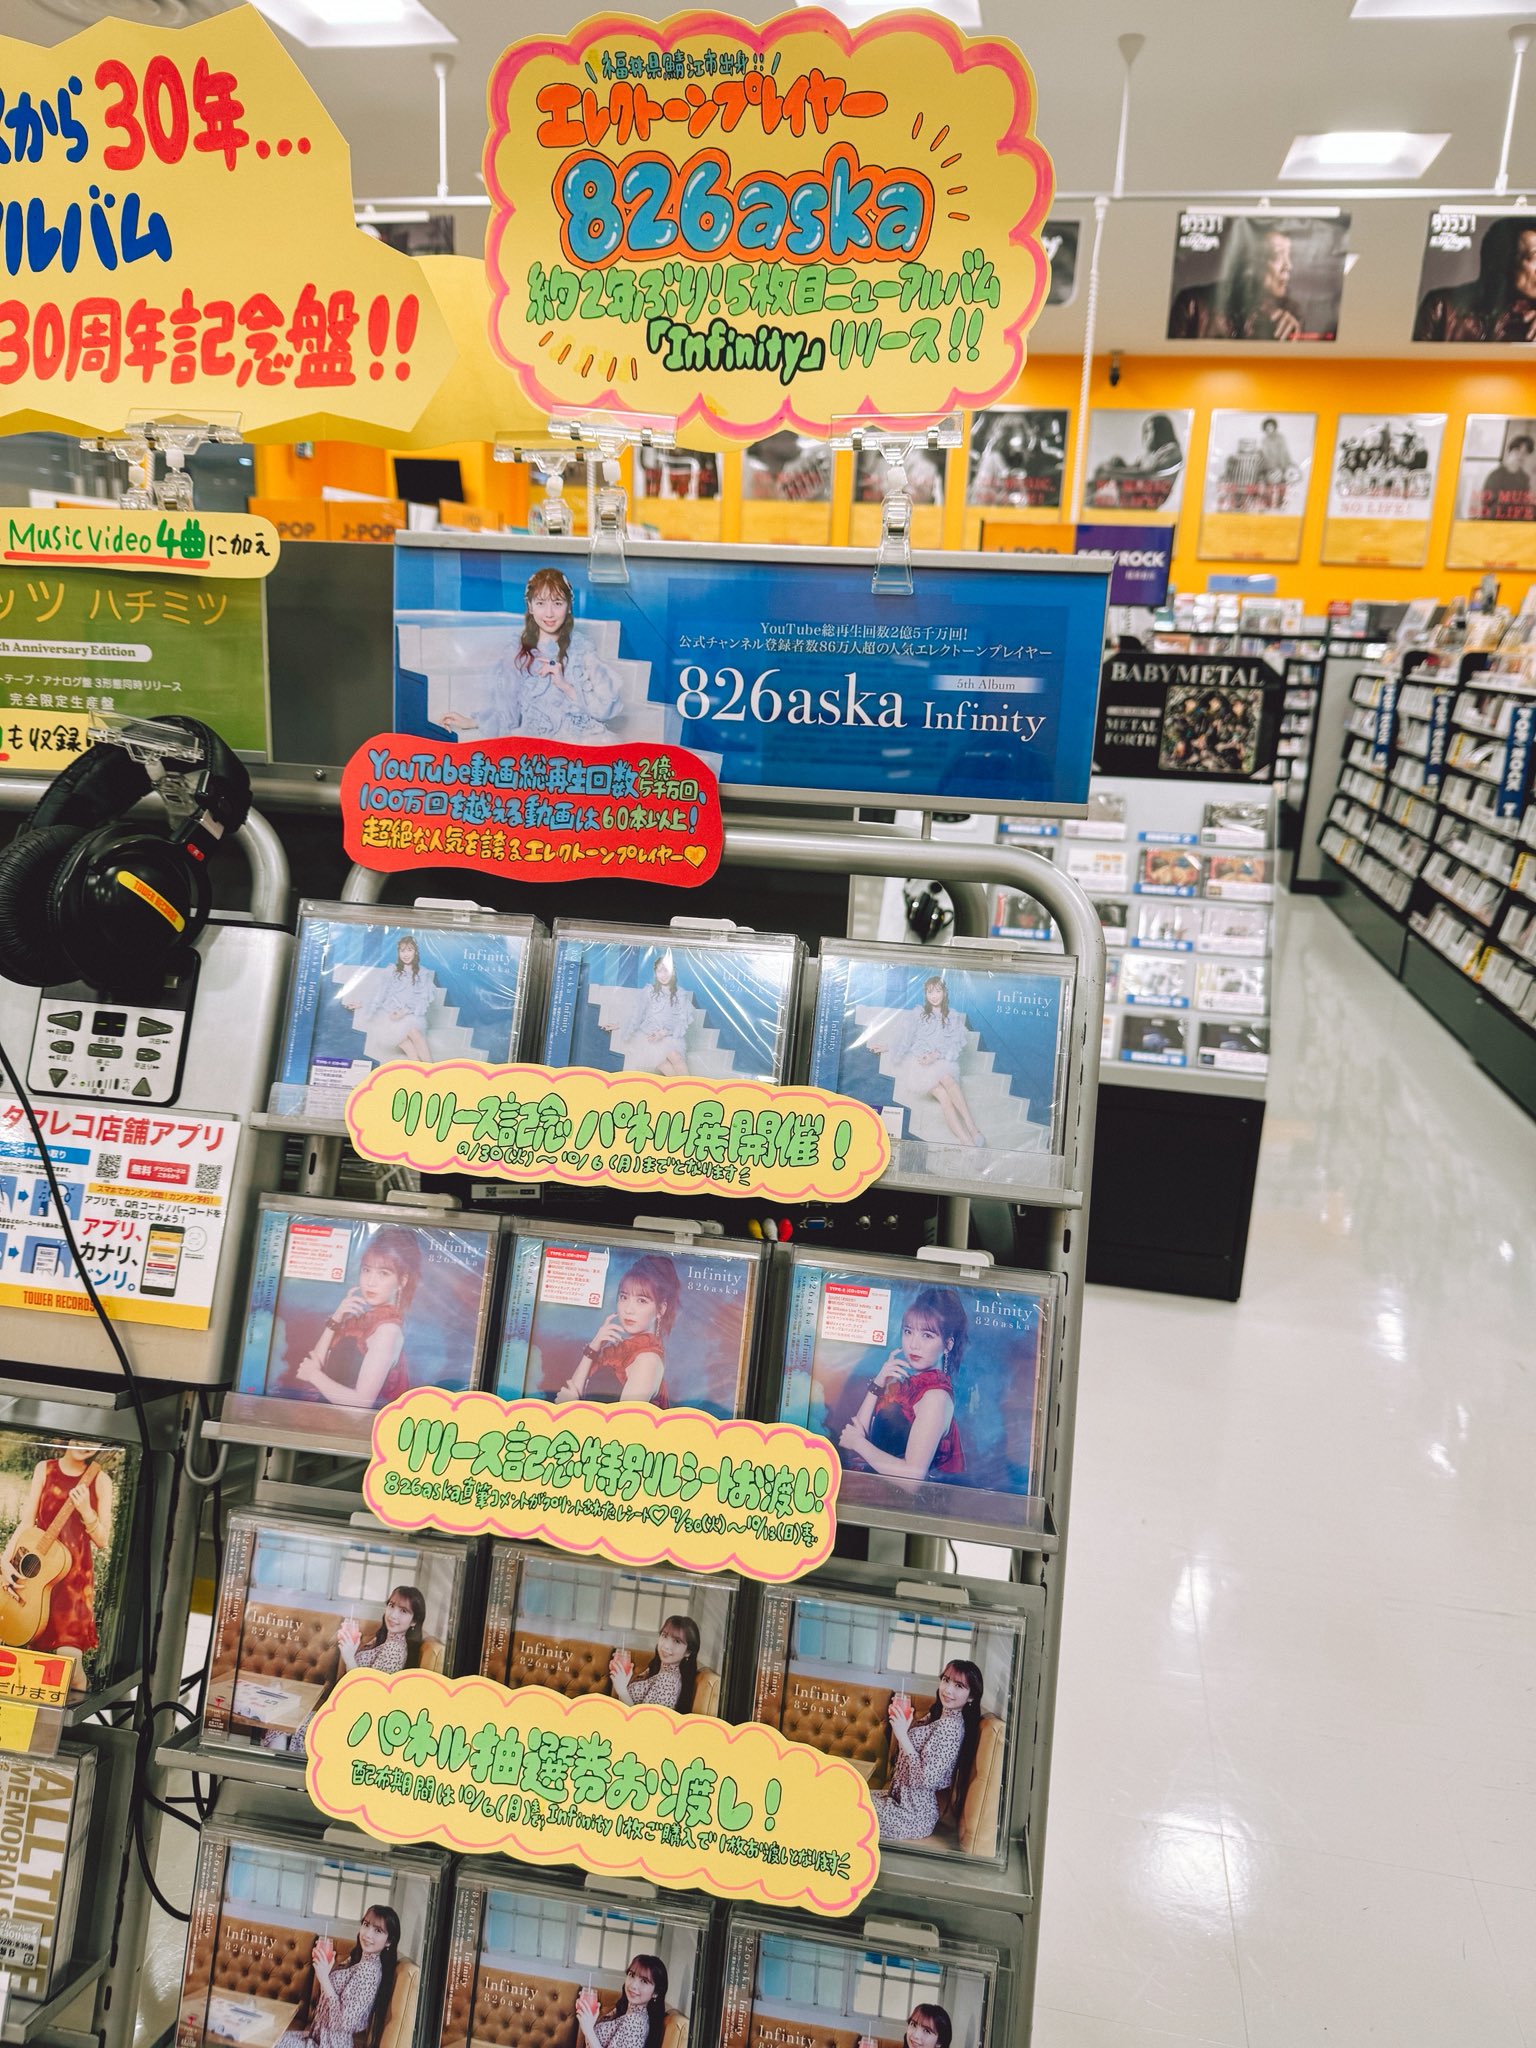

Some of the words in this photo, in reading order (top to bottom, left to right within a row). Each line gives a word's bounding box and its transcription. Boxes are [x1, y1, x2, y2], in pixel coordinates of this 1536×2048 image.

[0, 56, 311, 171] から30年...
[536, 69, 887, 148] エレクトーンプレイヤー
[553, 142, 935, 269] 826aska
[0, 185, 171, 275] ルバム
[526, 248, 1000, 324] 約2年ぶり!5枚目ニューアルバム
[90, 589, 227, 625] ハチミツ
[13, 643, 89, 657] Anniversary
[90, 645, 136, 658] Edition
[679, 635, 1052, 660] 公式チャンネル登録者数86万人超の人気エレクトーンプレイヤー
[956, 678, 975, 690] 5th
[978, 679, 1016, 691] Album
[1111, 662, 1265, 687] BABYMETAL
[10, 693, 115, 711] 完全限定生産盤
[676, 665, 908, 730] 826aska
[922, 701, 1046, 742] Infinity
[1105, 718, 1159, 732] METAL
[1104, 732, 1158, 747] FORTH
[996, 990, 1052, 1008] Infinity
[2, 1105, 224, 1152] タワレコ店舗アプリ
[131, 1164, 152, 1176] 無料
[82, 1218, 142, 1242] アプリ、
[80, 1242, 139, 1266] カナリ、
[429, 1239, 482, 1255] Infinity
[687, 1266, 742, 1284] Infinity
[687, 1282, 739, 1295] 826aska
[23, 1290, 54, 1307] TOWER
[55, 1294, 95, 1312] RECORDS
[974, 1301, 1033, 1320] Infinity
[974, 1315, 1031, 1331] 826aska
[799, 1335, 811, 1369] Infinity
[252, 1612, 303, 1631] Infinity
[777, 1602, 789, 1653] 826aska
[250, 1626, 302, 1642] 826aska
[496, 1617, 508, 1653] Infinity
[520, 1641, 574, 1661] Infinity
[519, 1656, 571, 1674] 826aska
[770, 1660, 782, 1698] Infinity
[794, 1684, 850, 1708] Infinity
[793, 1700, 848, 1717] 826aska
[347, 1709, 783, 1831] パネル抽選券お渡し!
[205, 1901, 216, 1938] Infinity
[226, 1926, 277, 1947] Infinity
[224, 1943, 275, 1960] 826aska
[461, 1952, 473, 1988] Infinity
[485, 1976, 539, 1998] Infinity
[484, 1993, 536, 2011] 826aska
[736, 2000, 747, 2038] Infinity
[758, 2025, 816, 2048] Infinity
